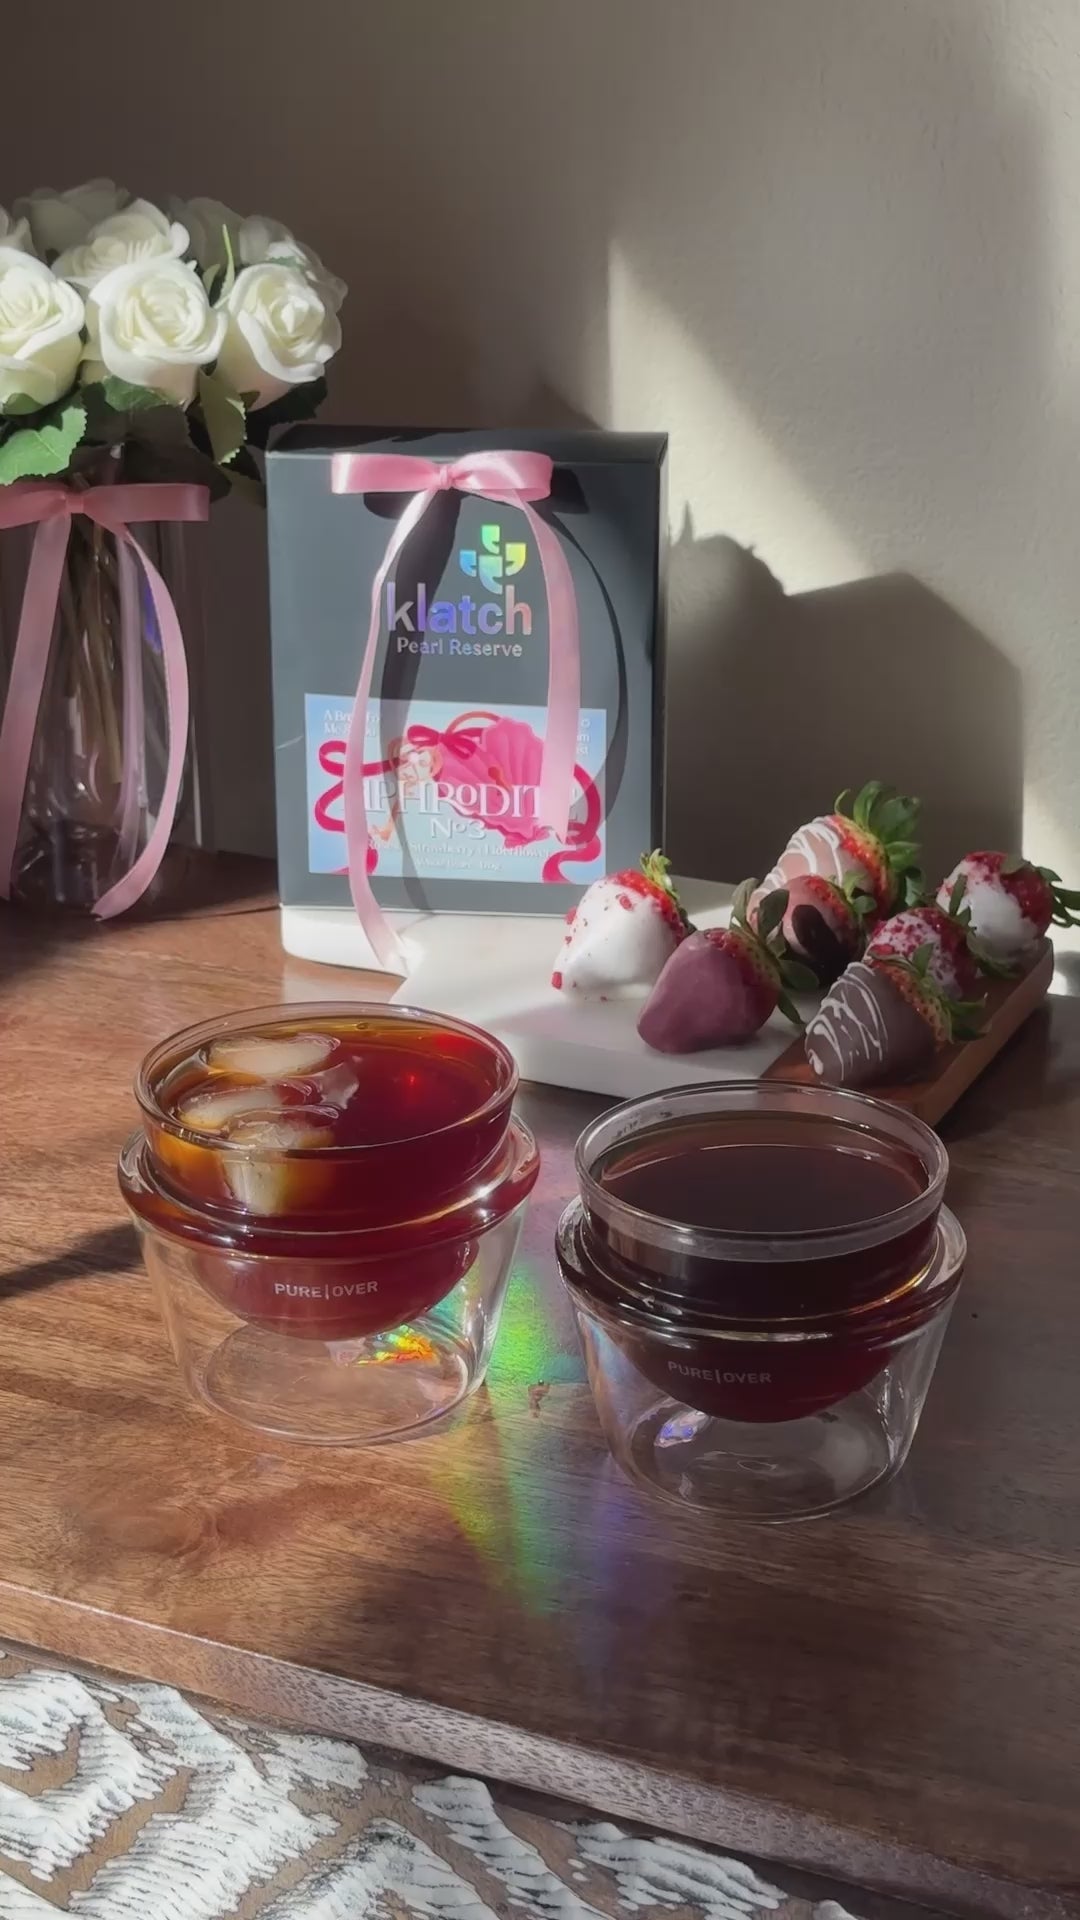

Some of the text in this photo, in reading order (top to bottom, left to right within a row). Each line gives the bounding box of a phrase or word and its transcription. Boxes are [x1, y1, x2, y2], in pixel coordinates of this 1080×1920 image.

[386, 581, 532, 635] klatch
[397, 637, 523, 657] Pearl Reserve
